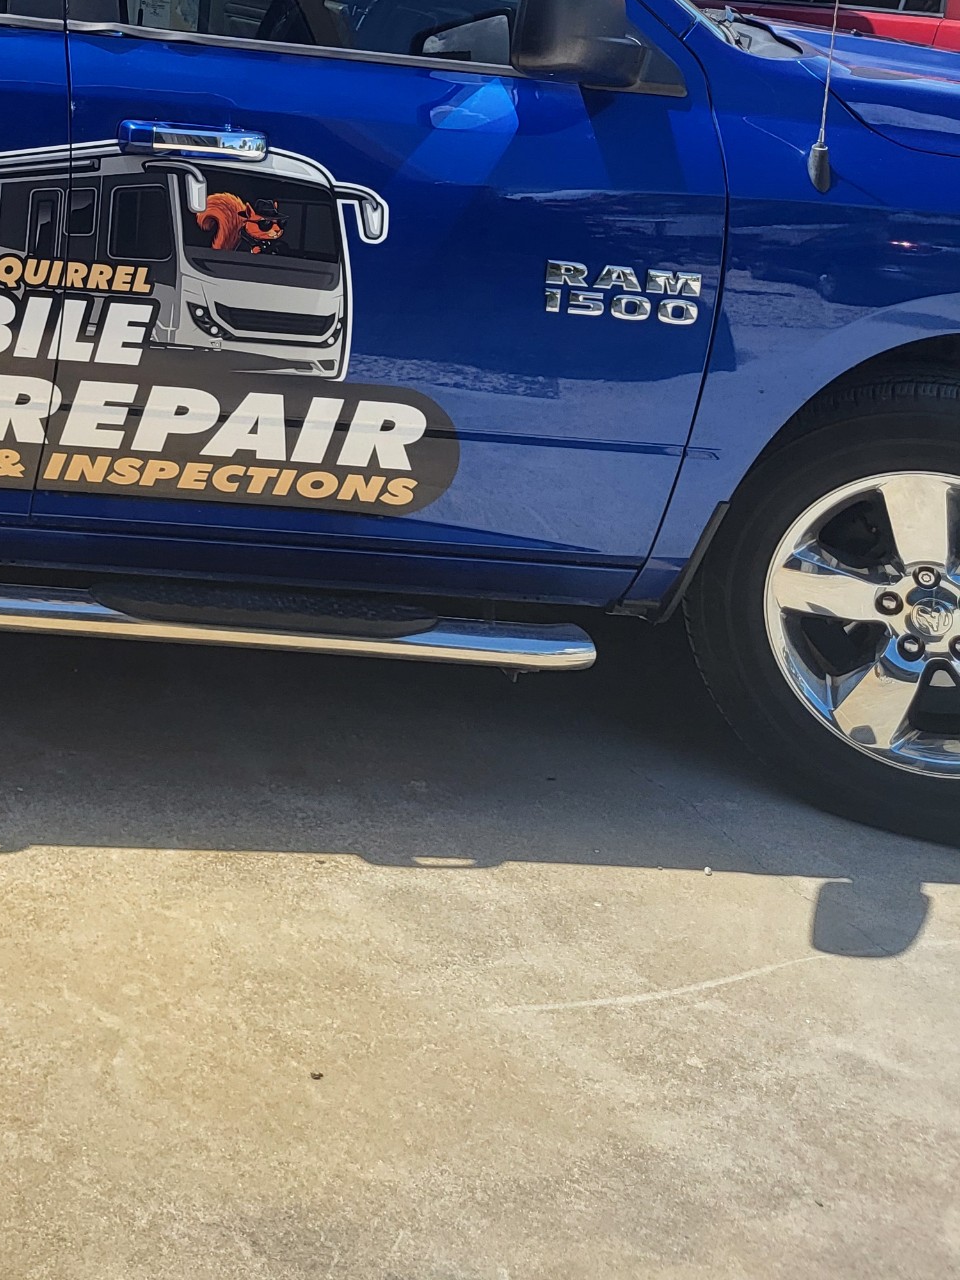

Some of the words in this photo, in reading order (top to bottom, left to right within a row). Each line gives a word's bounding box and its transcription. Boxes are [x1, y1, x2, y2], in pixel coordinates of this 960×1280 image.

[545, 259, 702, 297] RAM
[544, 287, 699, 325] 1500
[42, 453, 419, 506] INSPECTIONS
